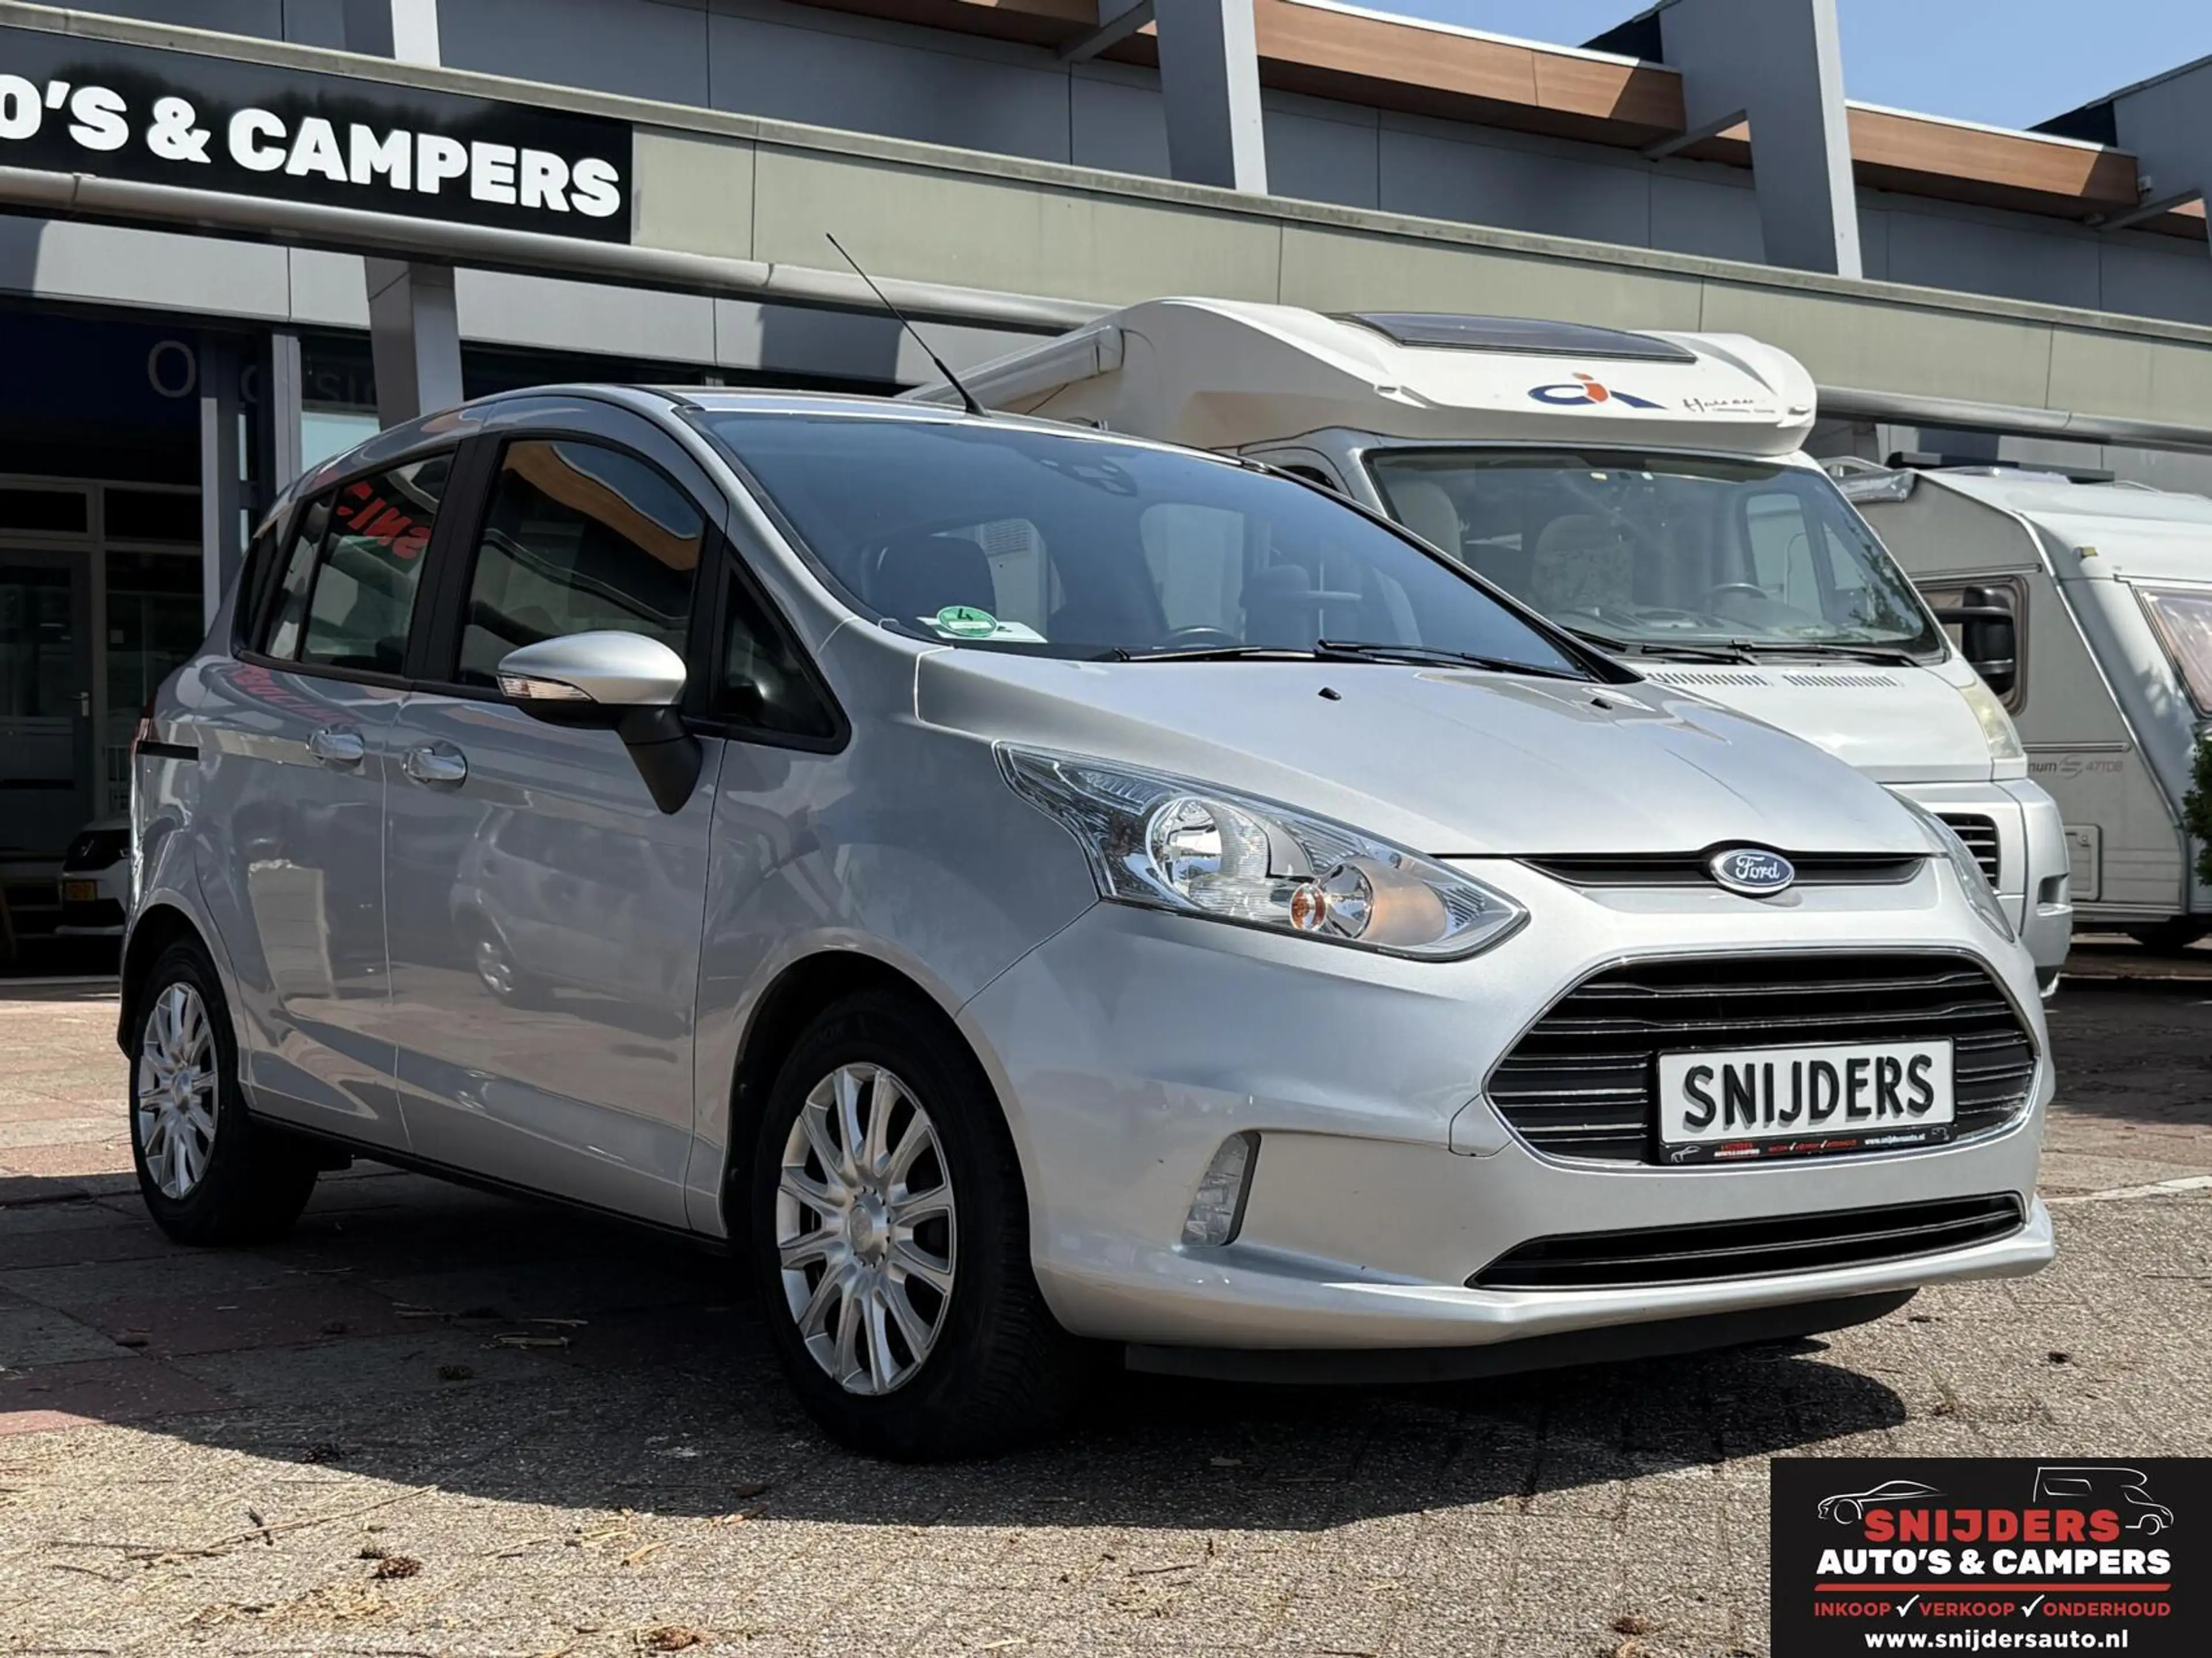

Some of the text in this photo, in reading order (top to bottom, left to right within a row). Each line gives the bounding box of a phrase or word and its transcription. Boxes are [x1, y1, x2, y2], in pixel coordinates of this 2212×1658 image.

[146, 97, 211, 164] &
[229, 108, 620, 217] CAMPERS
[1735, 855, 1780, 879] Ford
[1683, 1054, 1935, 1129] SNIJDERS
